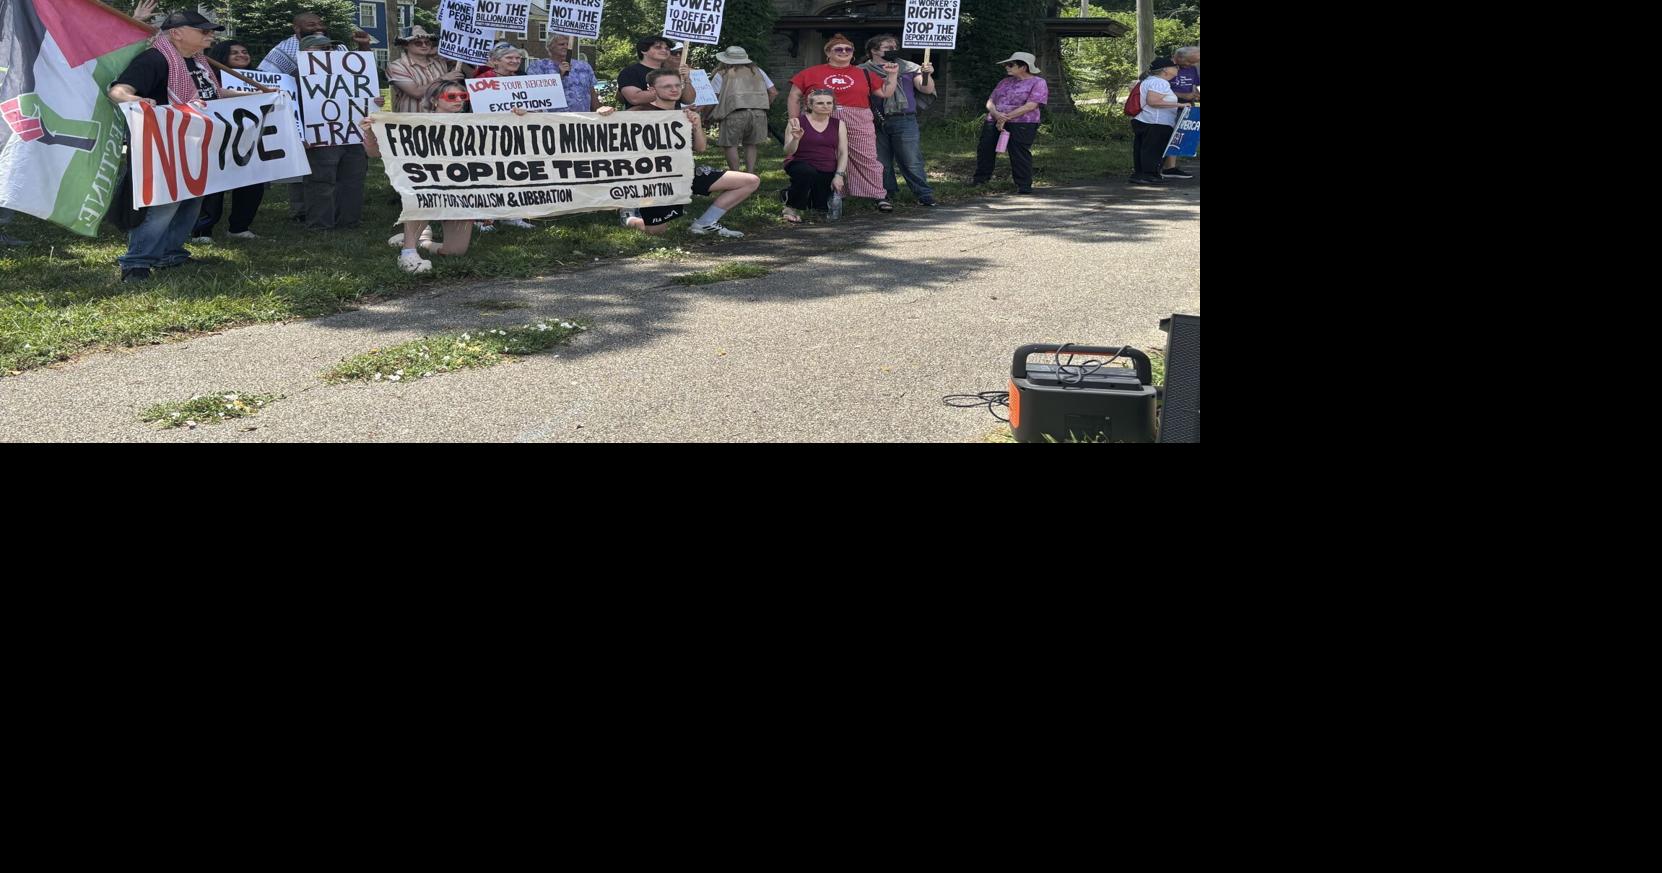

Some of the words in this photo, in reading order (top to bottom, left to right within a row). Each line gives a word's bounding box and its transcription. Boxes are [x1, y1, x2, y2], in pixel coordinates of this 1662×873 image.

[477, 1, 501, 14] NOT
[506, 4, 528, 17] THE
[555, 0, 600, 8] KERS
[476, 13, 526, 25] BILLIONAIRES!
[552, 5, 573, 19] NOT
[578, 10, 599, 23] THE
[669, 9, 679, 18] TO
[682, 11, 720, 24] DEFEAT
[908, 7, 956, 20] RIGHTS!
[454, 20, 482, 35] NEEDS
[551, 18, 597, 31] BILLIONAIRES!
[672, 19, 715, 35] TRUMP!
[906, 22, 934, 33] STOP
[937, 25, 954, 34] THE
[440, 41, 456, 51] WAR
[442, 29, 463, 43] NOT
[468, 36, 492, 51] THE
[307, 51, 366, 75] NO
[301, 74, 375, 99] WAR
[469, 79, 500, 92] LOVE
[502, 81, 523, 91] YOUR
[525, 79, 558, 89] NEIGHBOR
[512, 91, 528, 100] NO
[321, 98, 369, 121] ON
[489, 99, 552, 112] EXCEPTIONS
[306, 120, 364, 146] IRA
[385, 123, 447, 158] FROM
[449, 124, 526, 157] DAYTON
[527, 124, 555, 155] TO
[559, 121, 686, 153] MINNEAPOLIS
[140, 101, 213, 205] NO
[214, 104, 285, 171] ICE
[402, 161, 493, 183] STOP
[495, 160, 548, 181] ICE
[552, 156, 672, 179] TERROR
[416, 193, 442, 208] PARTY
[456, 192, 505, 208] SOCIALISM
[507, 191, 519, 207] &
[518, 188, 573, 207] LIBERATION
[609, 182, 674, 200] @PSL.DAYTON
